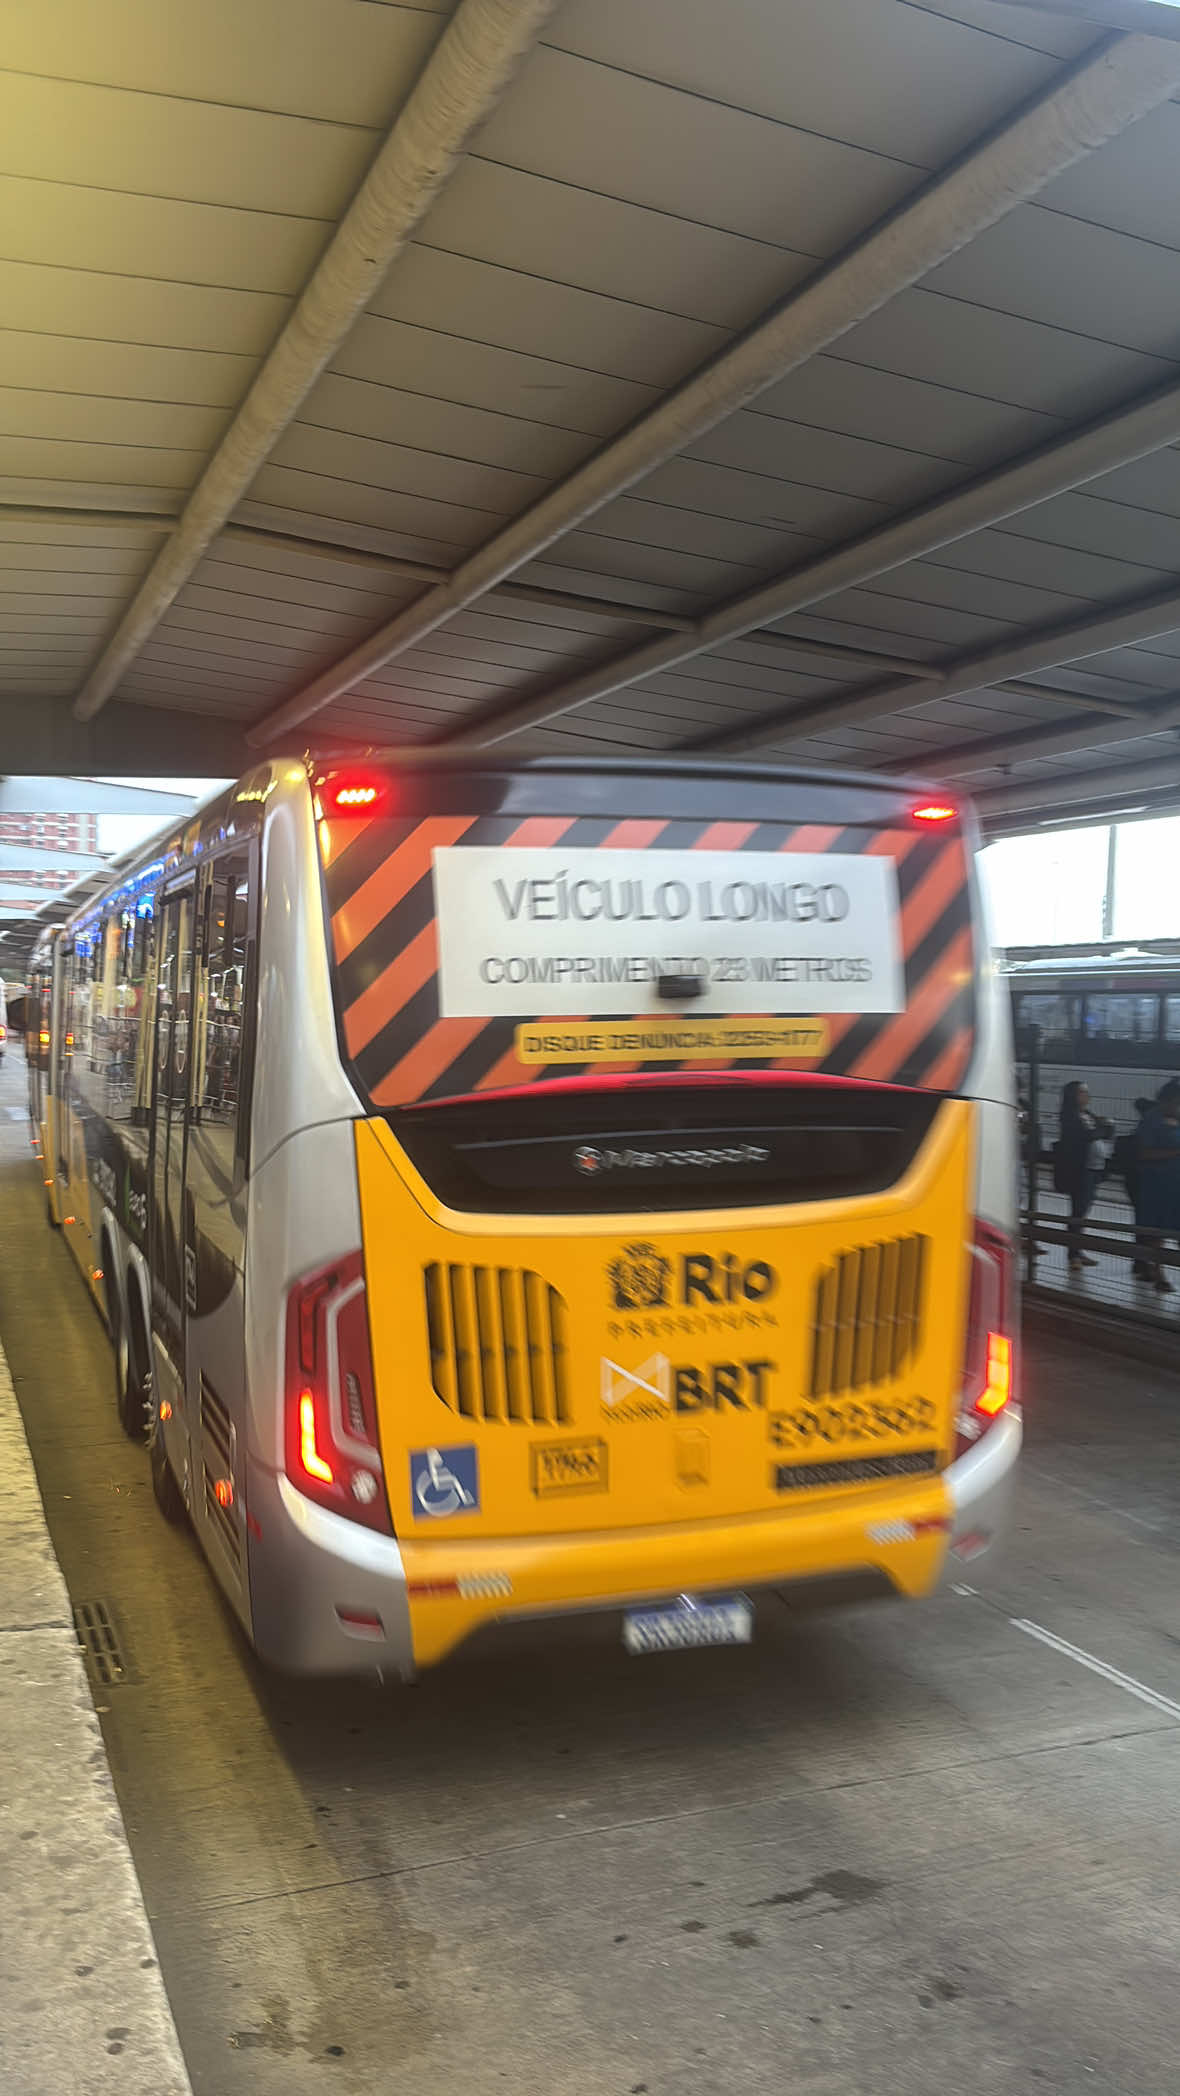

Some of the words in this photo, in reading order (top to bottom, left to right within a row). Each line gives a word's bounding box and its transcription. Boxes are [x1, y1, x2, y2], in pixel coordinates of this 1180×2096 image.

[493, 869, 691, 922] VEÍCULO
[698, 880, 851, 923] LONGO
[480, 956, 708, 985] COMPRIMENTO
[752, 956, 874, 984] METROS
[524, 1034, 605, 1053] DISQUE
[677, 1251, 782, 1307] Rio
[672, 1357, 780, 1416] BRT
